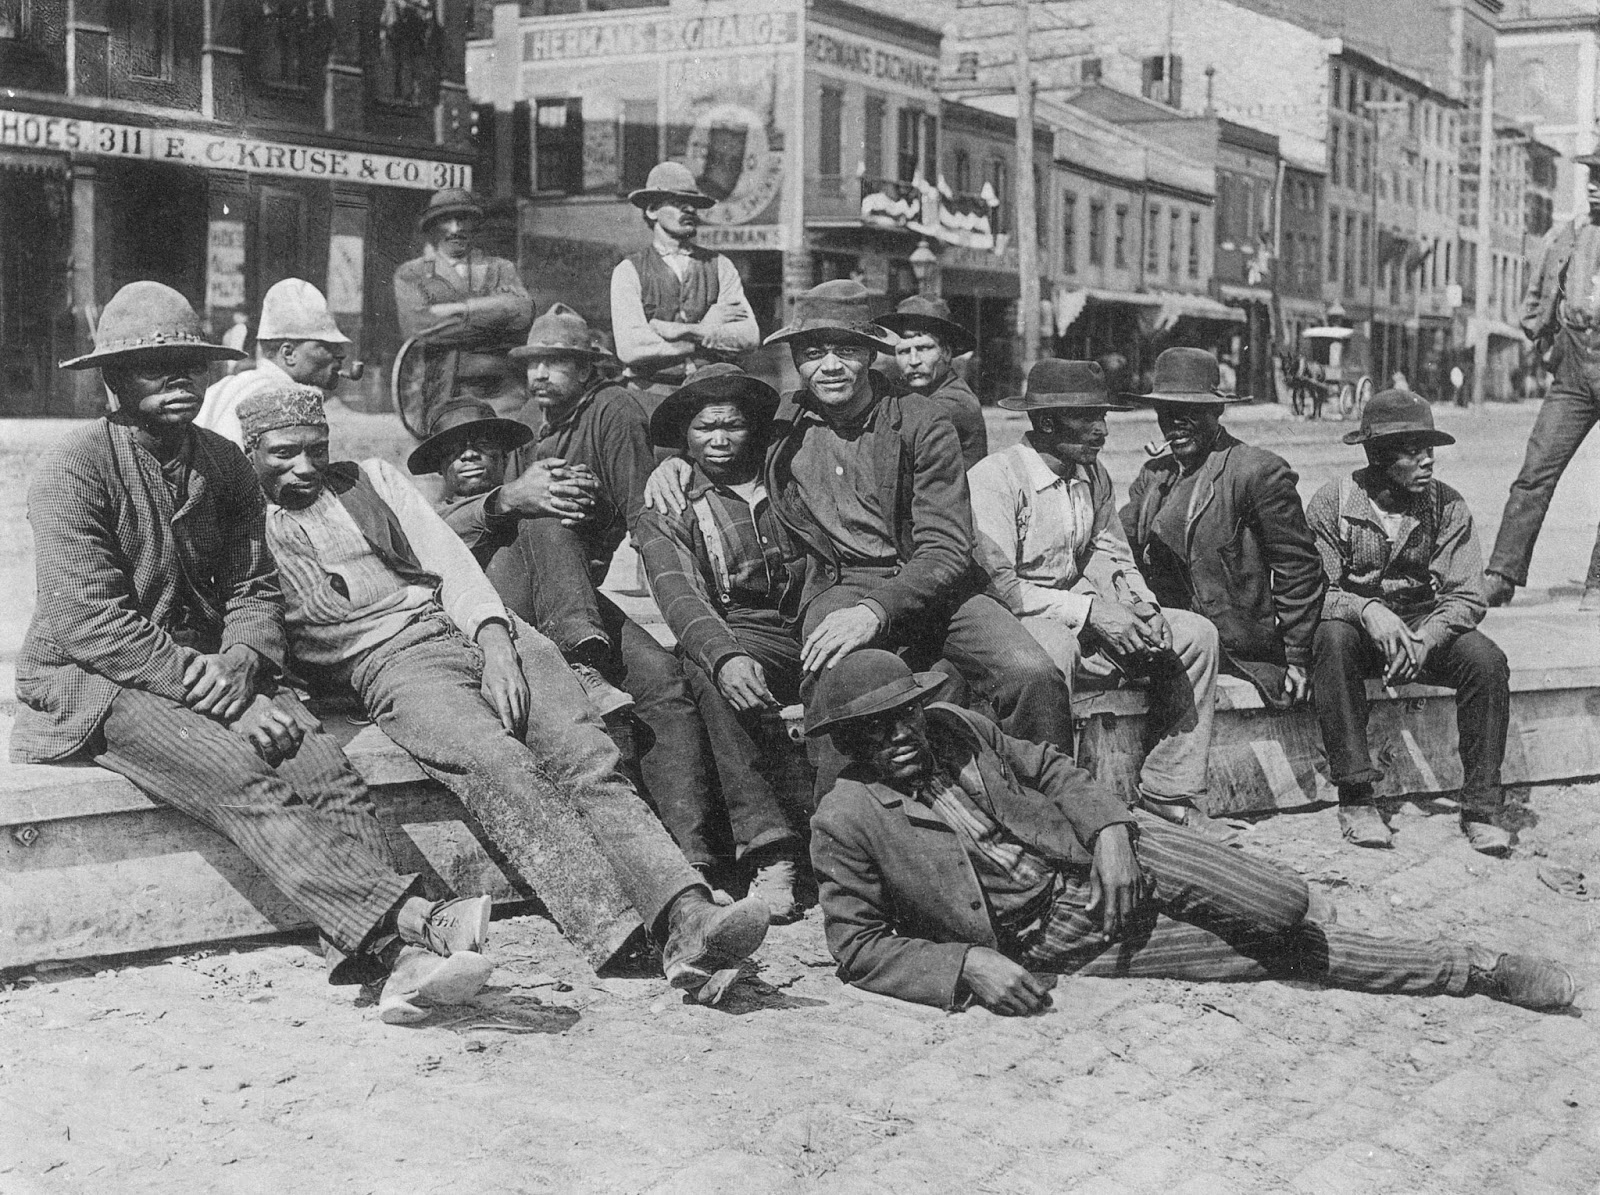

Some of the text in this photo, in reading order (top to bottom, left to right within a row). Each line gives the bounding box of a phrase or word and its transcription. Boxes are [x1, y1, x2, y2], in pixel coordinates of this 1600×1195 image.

[100, 126, 142, 155] 311
[236, 143, 349, 175] KRUSE
[357, 158, 379, 180] &
[434, 162, 466, 189] 311
